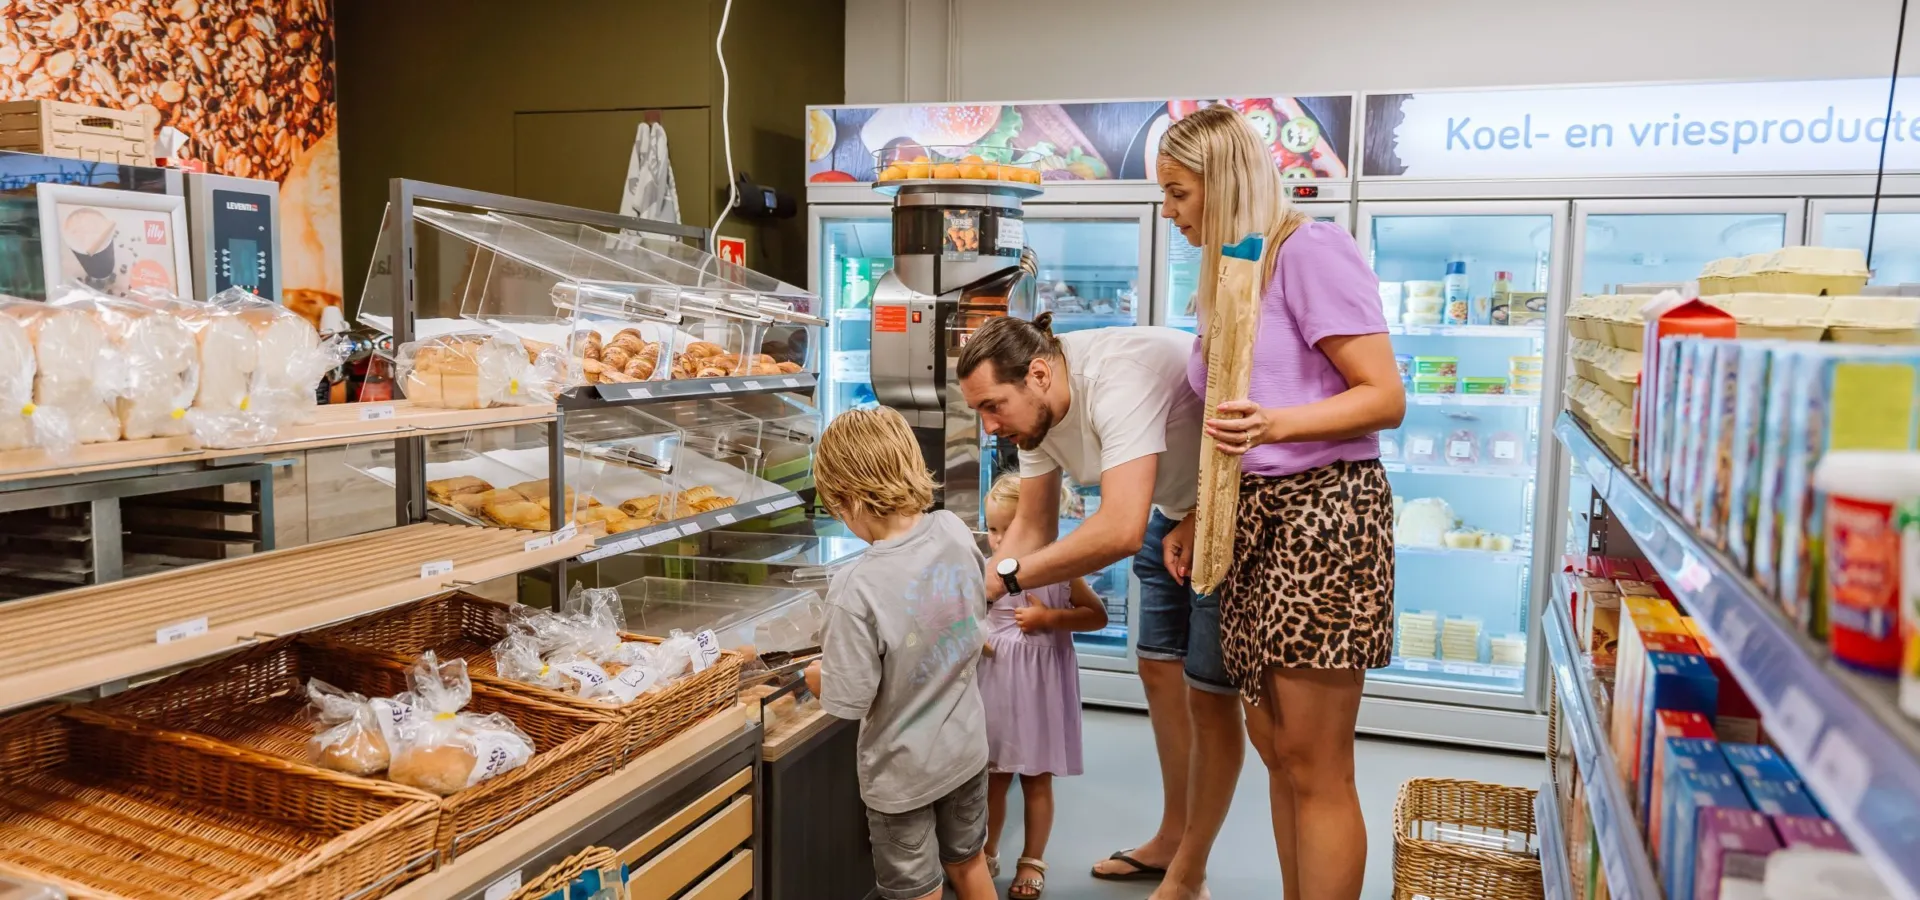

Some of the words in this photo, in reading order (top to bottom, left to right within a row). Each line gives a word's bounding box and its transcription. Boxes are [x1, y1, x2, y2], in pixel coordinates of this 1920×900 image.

[1446, 113, 1550, 150] Koel-
[1565, 123, 1613, 148] en
[147, 224, 164, 241] illy
